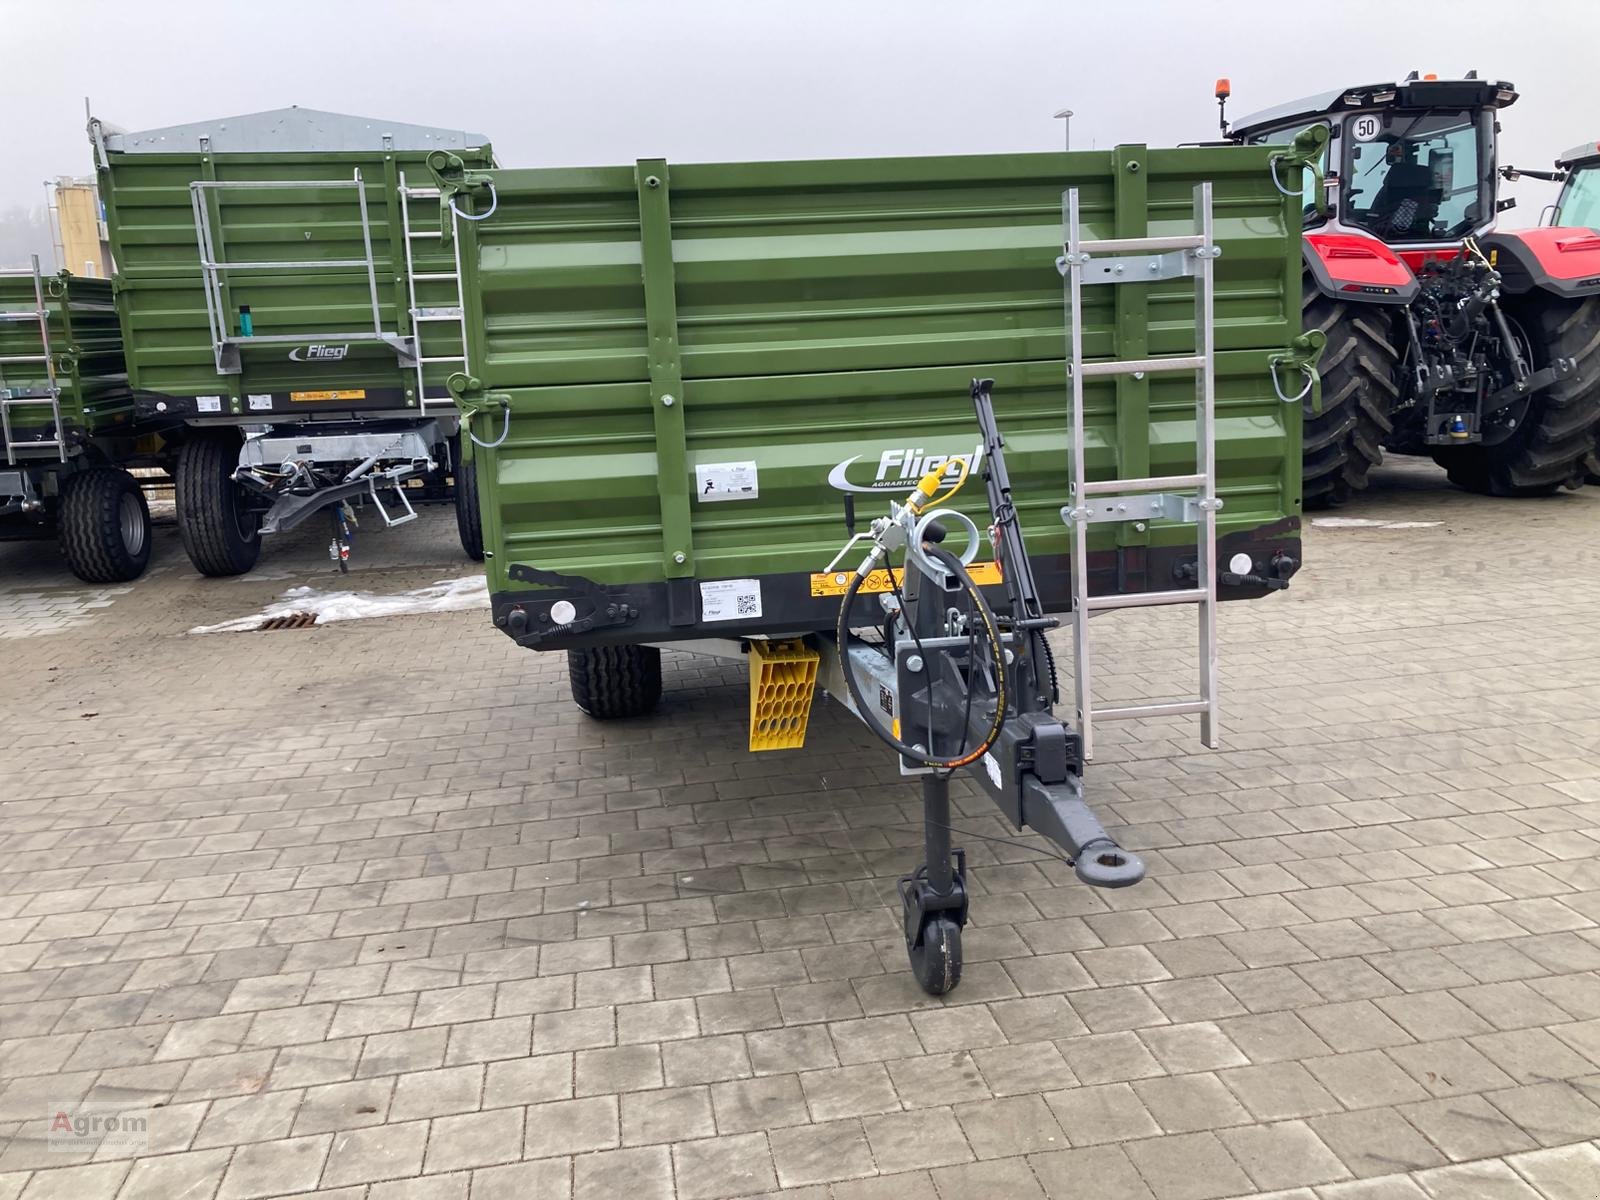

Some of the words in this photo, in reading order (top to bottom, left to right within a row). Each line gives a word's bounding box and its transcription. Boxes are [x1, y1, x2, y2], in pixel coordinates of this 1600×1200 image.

[1359, 119, 1374, 136] 50
[307, 343, 349, 359] Fliegl
[872, 479, 918, 488] AGRARTEC
